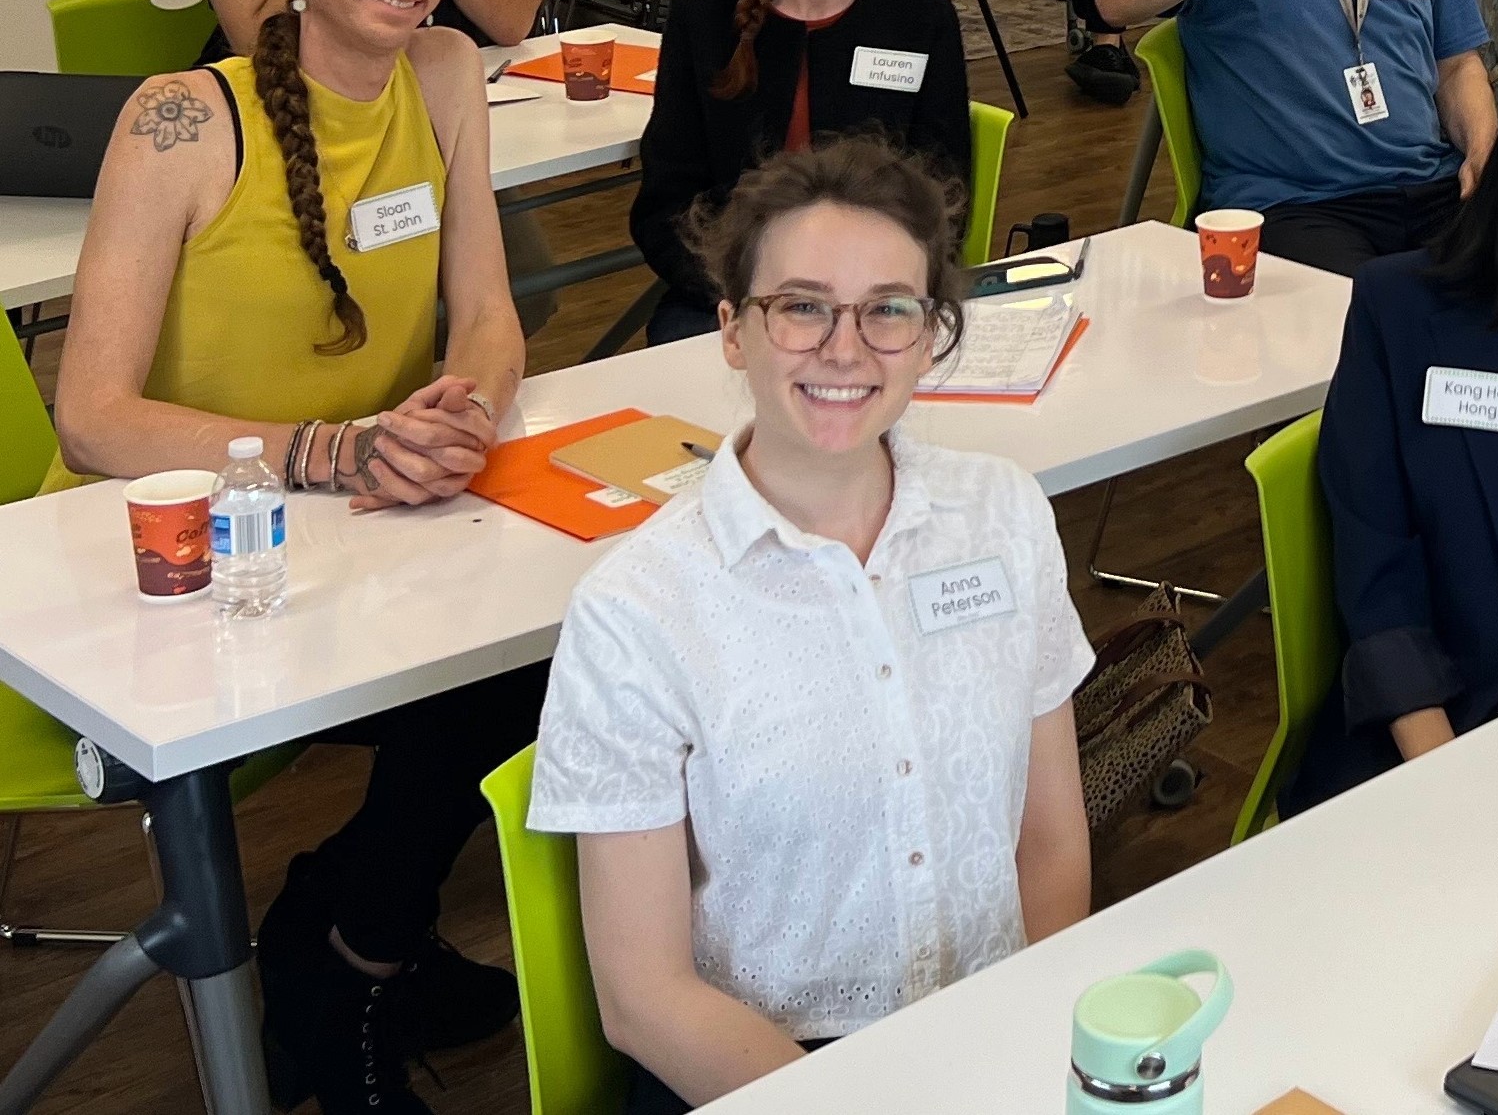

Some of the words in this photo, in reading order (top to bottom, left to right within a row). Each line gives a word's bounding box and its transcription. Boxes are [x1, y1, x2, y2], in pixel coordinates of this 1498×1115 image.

[872, 56, 913, 69] Lauren
[869, 71, 915, 85] Infusino
[376, 201, 411, 219] Sloan
[392, 214, 422, 232] John
[1444, 380, 1482, 401] Kang
[1458, 400, 1497, 420] Hong
[941, 575, 981, 596] Anna
[931, 589, 1002, 617] Peterson
